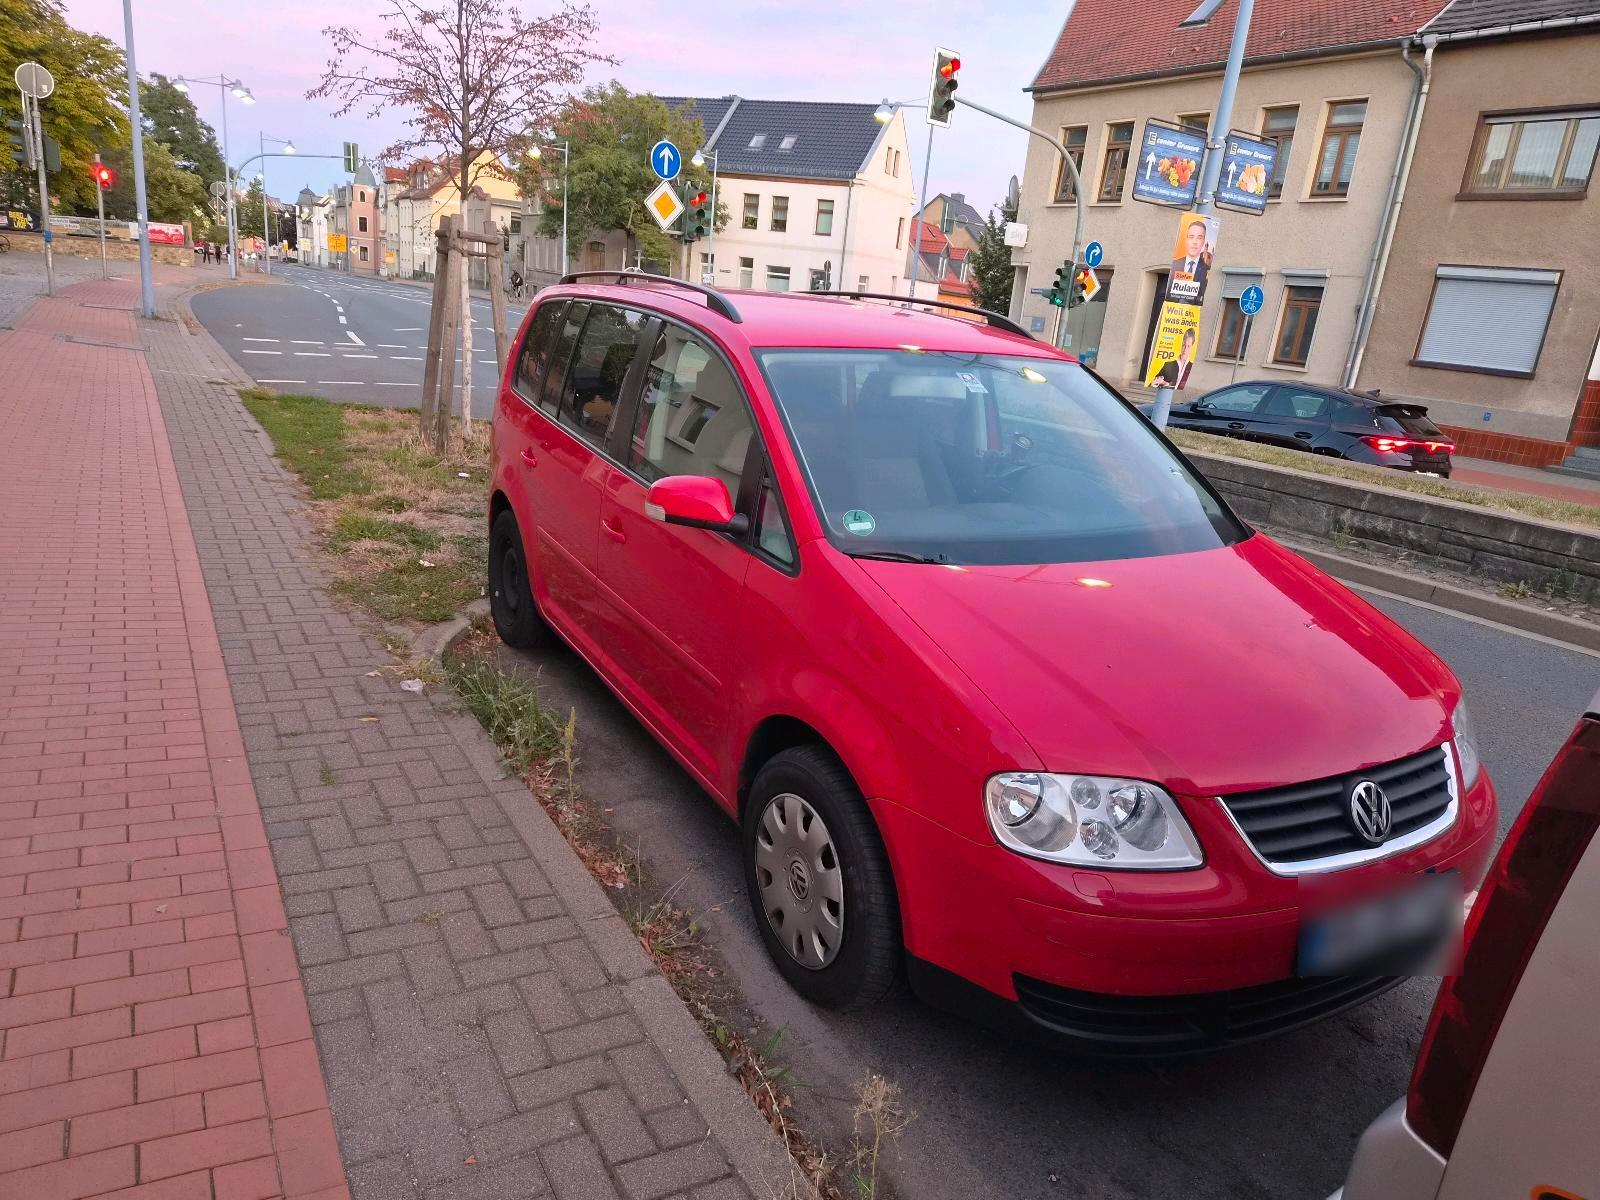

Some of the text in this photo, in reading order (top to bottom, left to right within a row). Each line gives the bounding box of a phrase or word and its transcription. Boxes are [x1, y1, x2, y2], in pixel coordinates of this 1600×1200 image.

[1166, 306, 1184, 316] Weil
[1165, 317, 1180, 326] was
[1162, 326, 1185, 335] muss.
[1156, 350, 1175, 360] FDP
